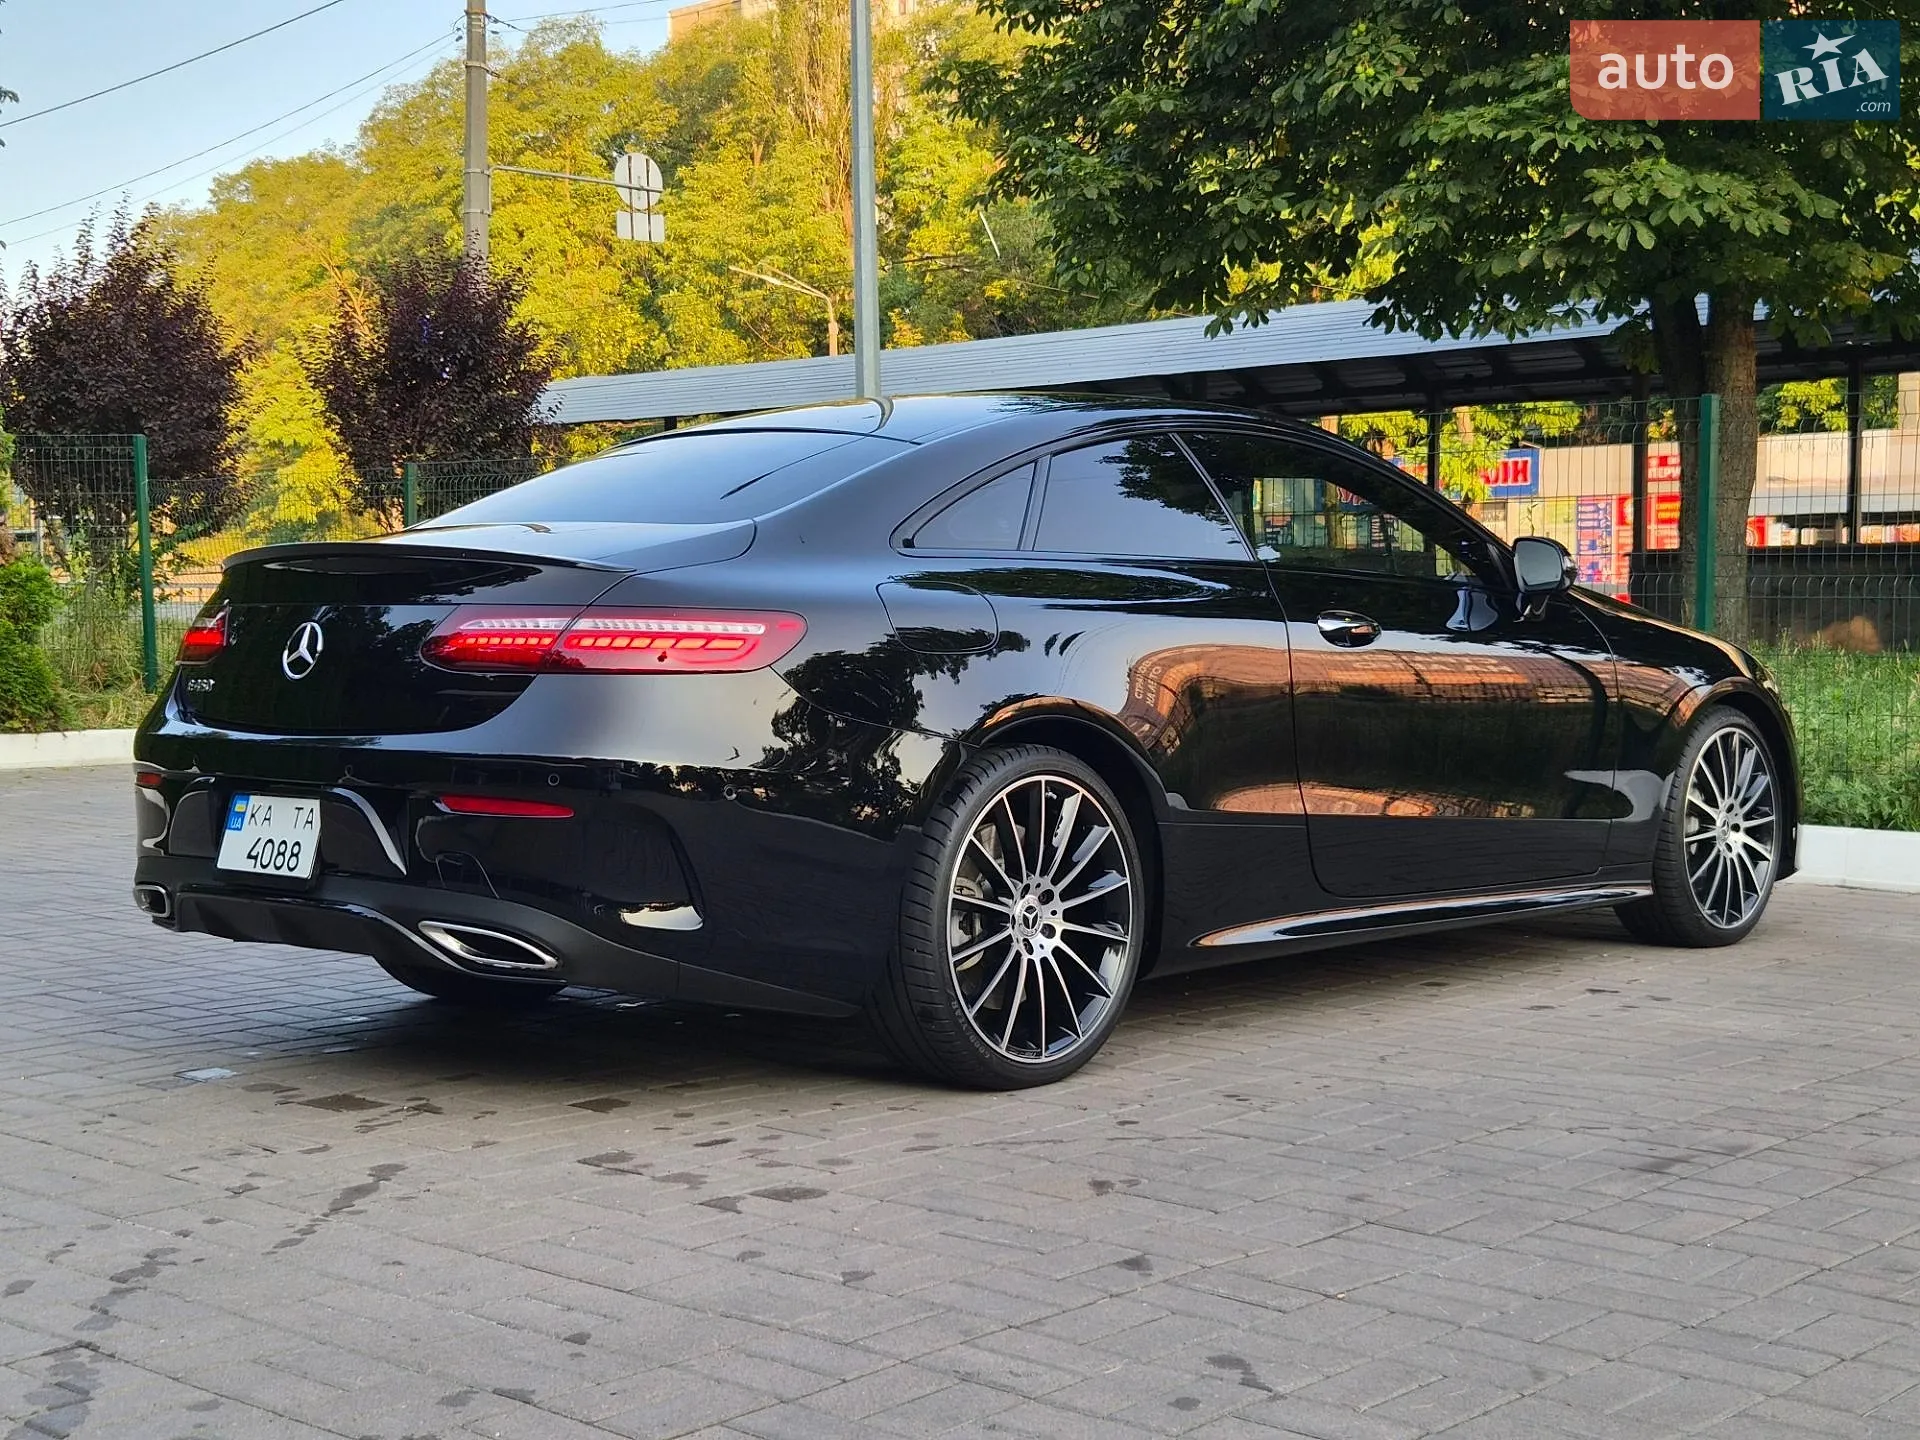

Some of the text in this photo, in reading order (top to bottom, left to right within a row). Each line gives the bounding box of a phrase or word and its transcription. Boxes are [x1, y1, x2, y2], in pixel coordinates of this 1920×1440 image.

[231, 816, 242, 829] UA
[248, 804, 314, 830] KA TA
[246, 837, 301, 872] 4088
